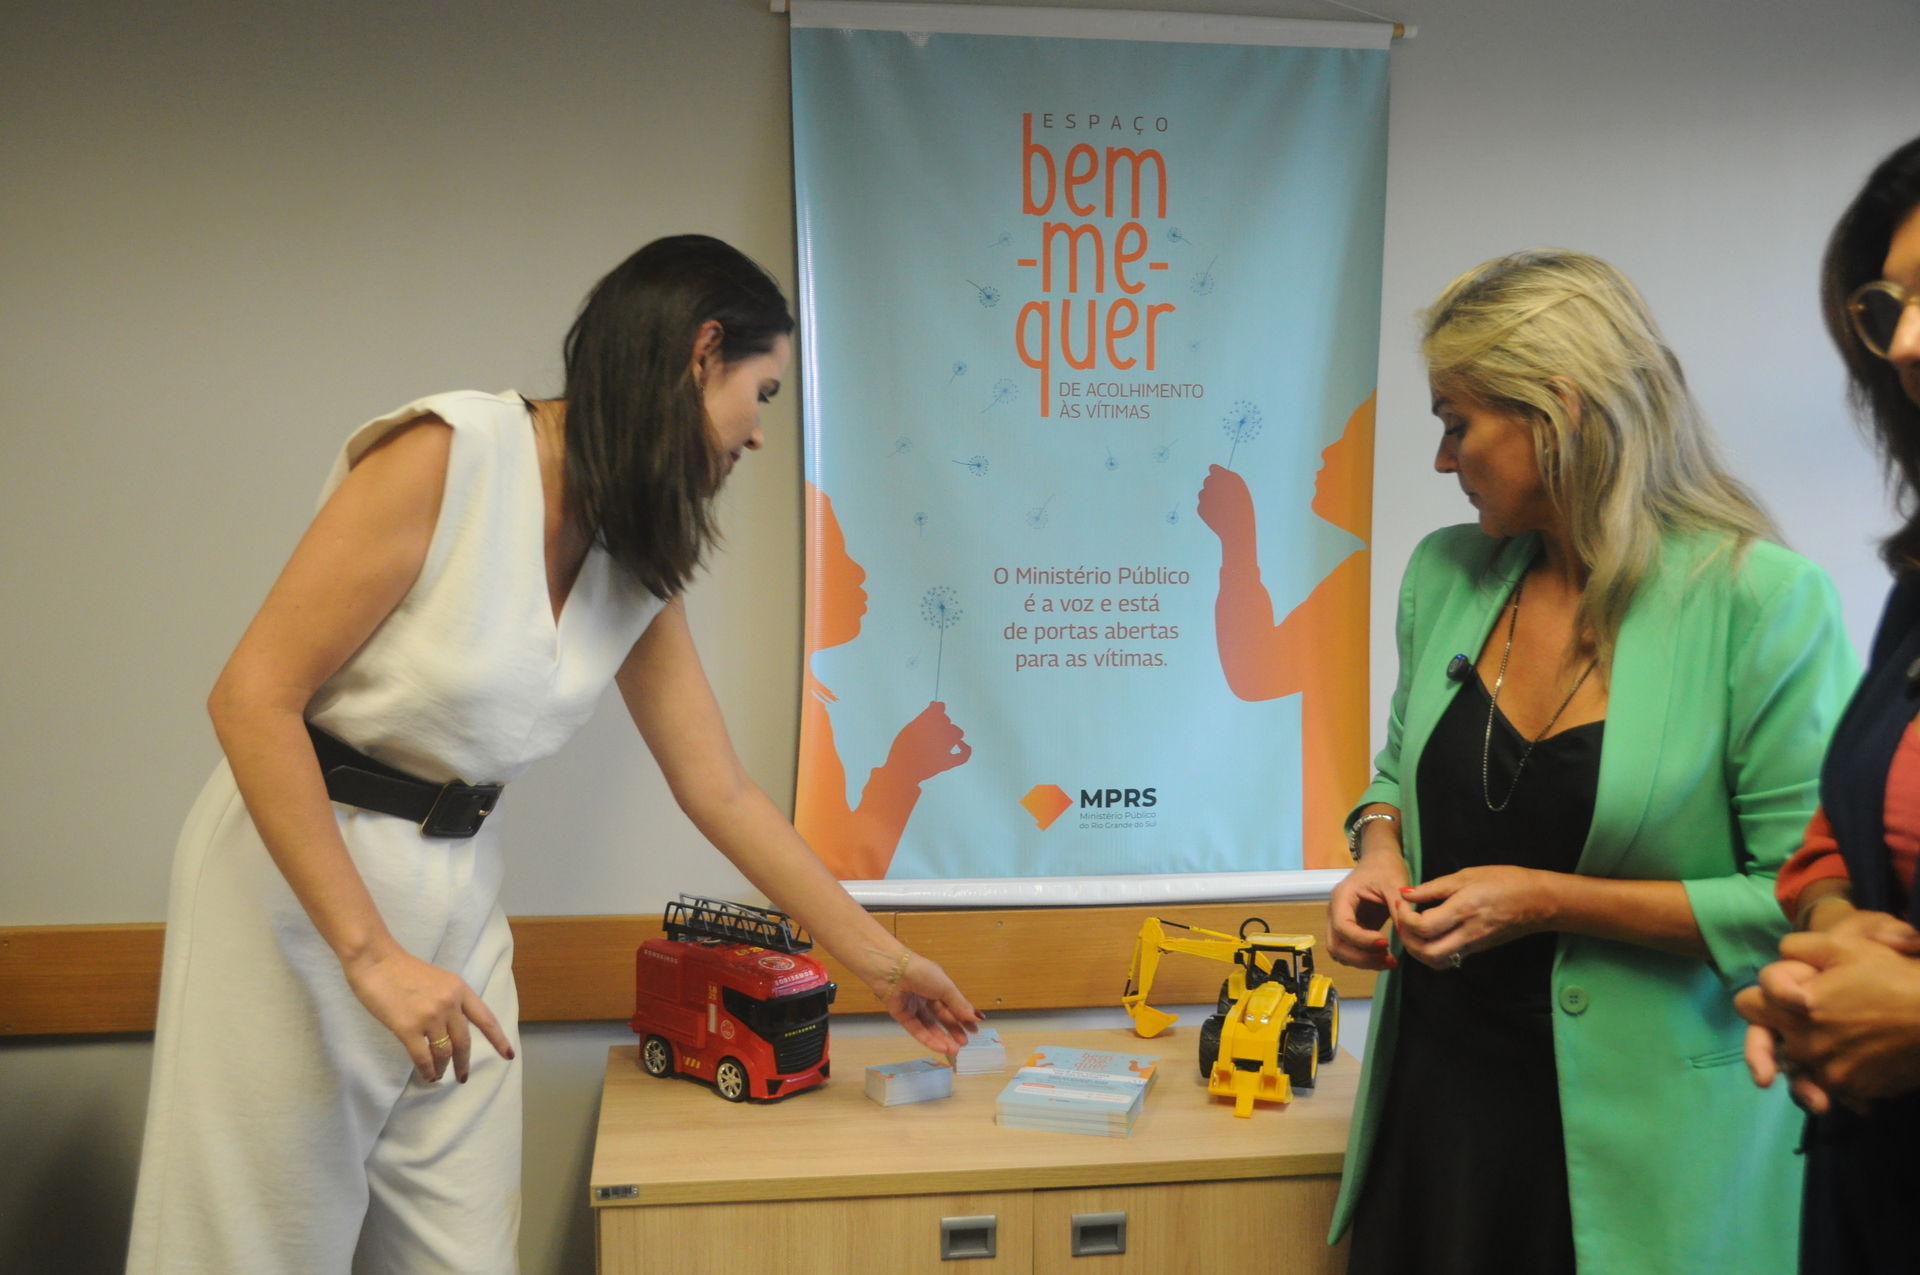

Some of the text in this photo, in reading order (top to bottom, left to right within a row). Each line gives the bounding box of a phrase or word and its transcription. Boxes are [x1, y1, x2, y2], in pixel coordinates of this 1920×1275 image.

[1043, 113, 1169, 135] ESPAÇO
[1022, 112, 1167, 219] bem
[1015, 297, 1177, 417] quer
[1059, 382, 1204, 399] DE ACOLHIMENTO
[1059, 400, 1150, 420] ÀS VÍTIMAS
[993, 565, 1190, 585] O Ministério Público
[1024, 593, 1160, 612] é a voz e está
[1003, 621, 1179, 644] de portas abertas
[1016, 648, 1168, 672] para as vítimas.
[1080, 787, 1157, 808] MPRS
[1080, 811, 1156, 820] Ministério Público
[1105, 821, 1133, 829] Grande
[1145, 820, 1157, 828] Sul
